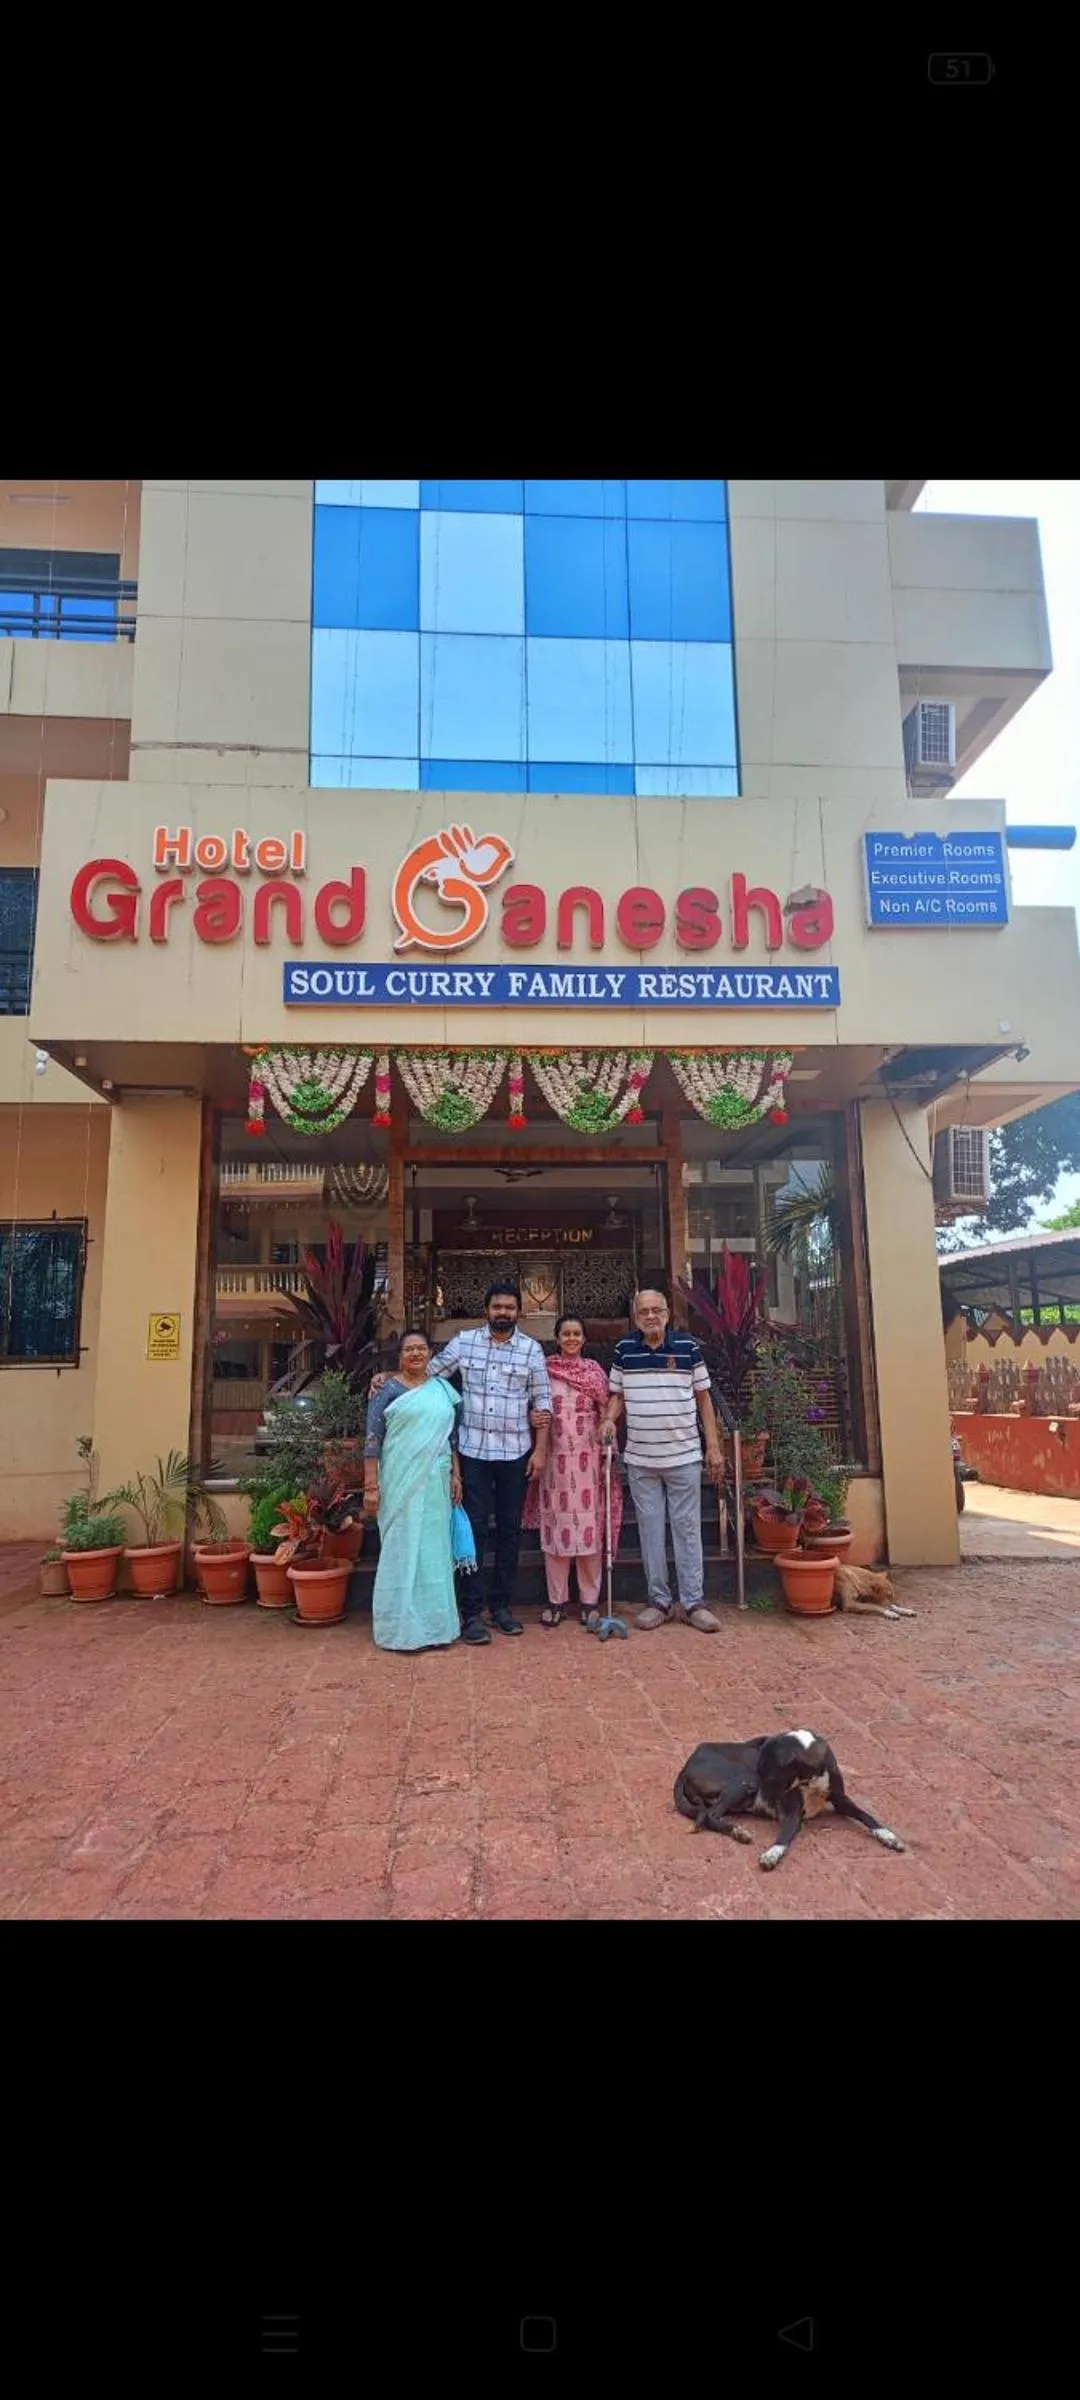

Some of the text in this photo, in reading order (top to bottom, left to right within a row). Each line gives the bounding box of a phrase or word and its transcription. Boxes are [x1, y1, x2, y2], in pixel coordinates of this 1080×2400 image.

[153, 826, 305, 874] Hotel
[874, 843, 995, 857] Premier Rooms
[70, 823, 835, 953] Grand Ganesha
[871, 871, 1002, 885] Executive Rooms
[880, 899, 998, 913] Non A/C Rooms
[290, 969, 833, 998] SOUL CURRY FAMILY RESTAURANT
